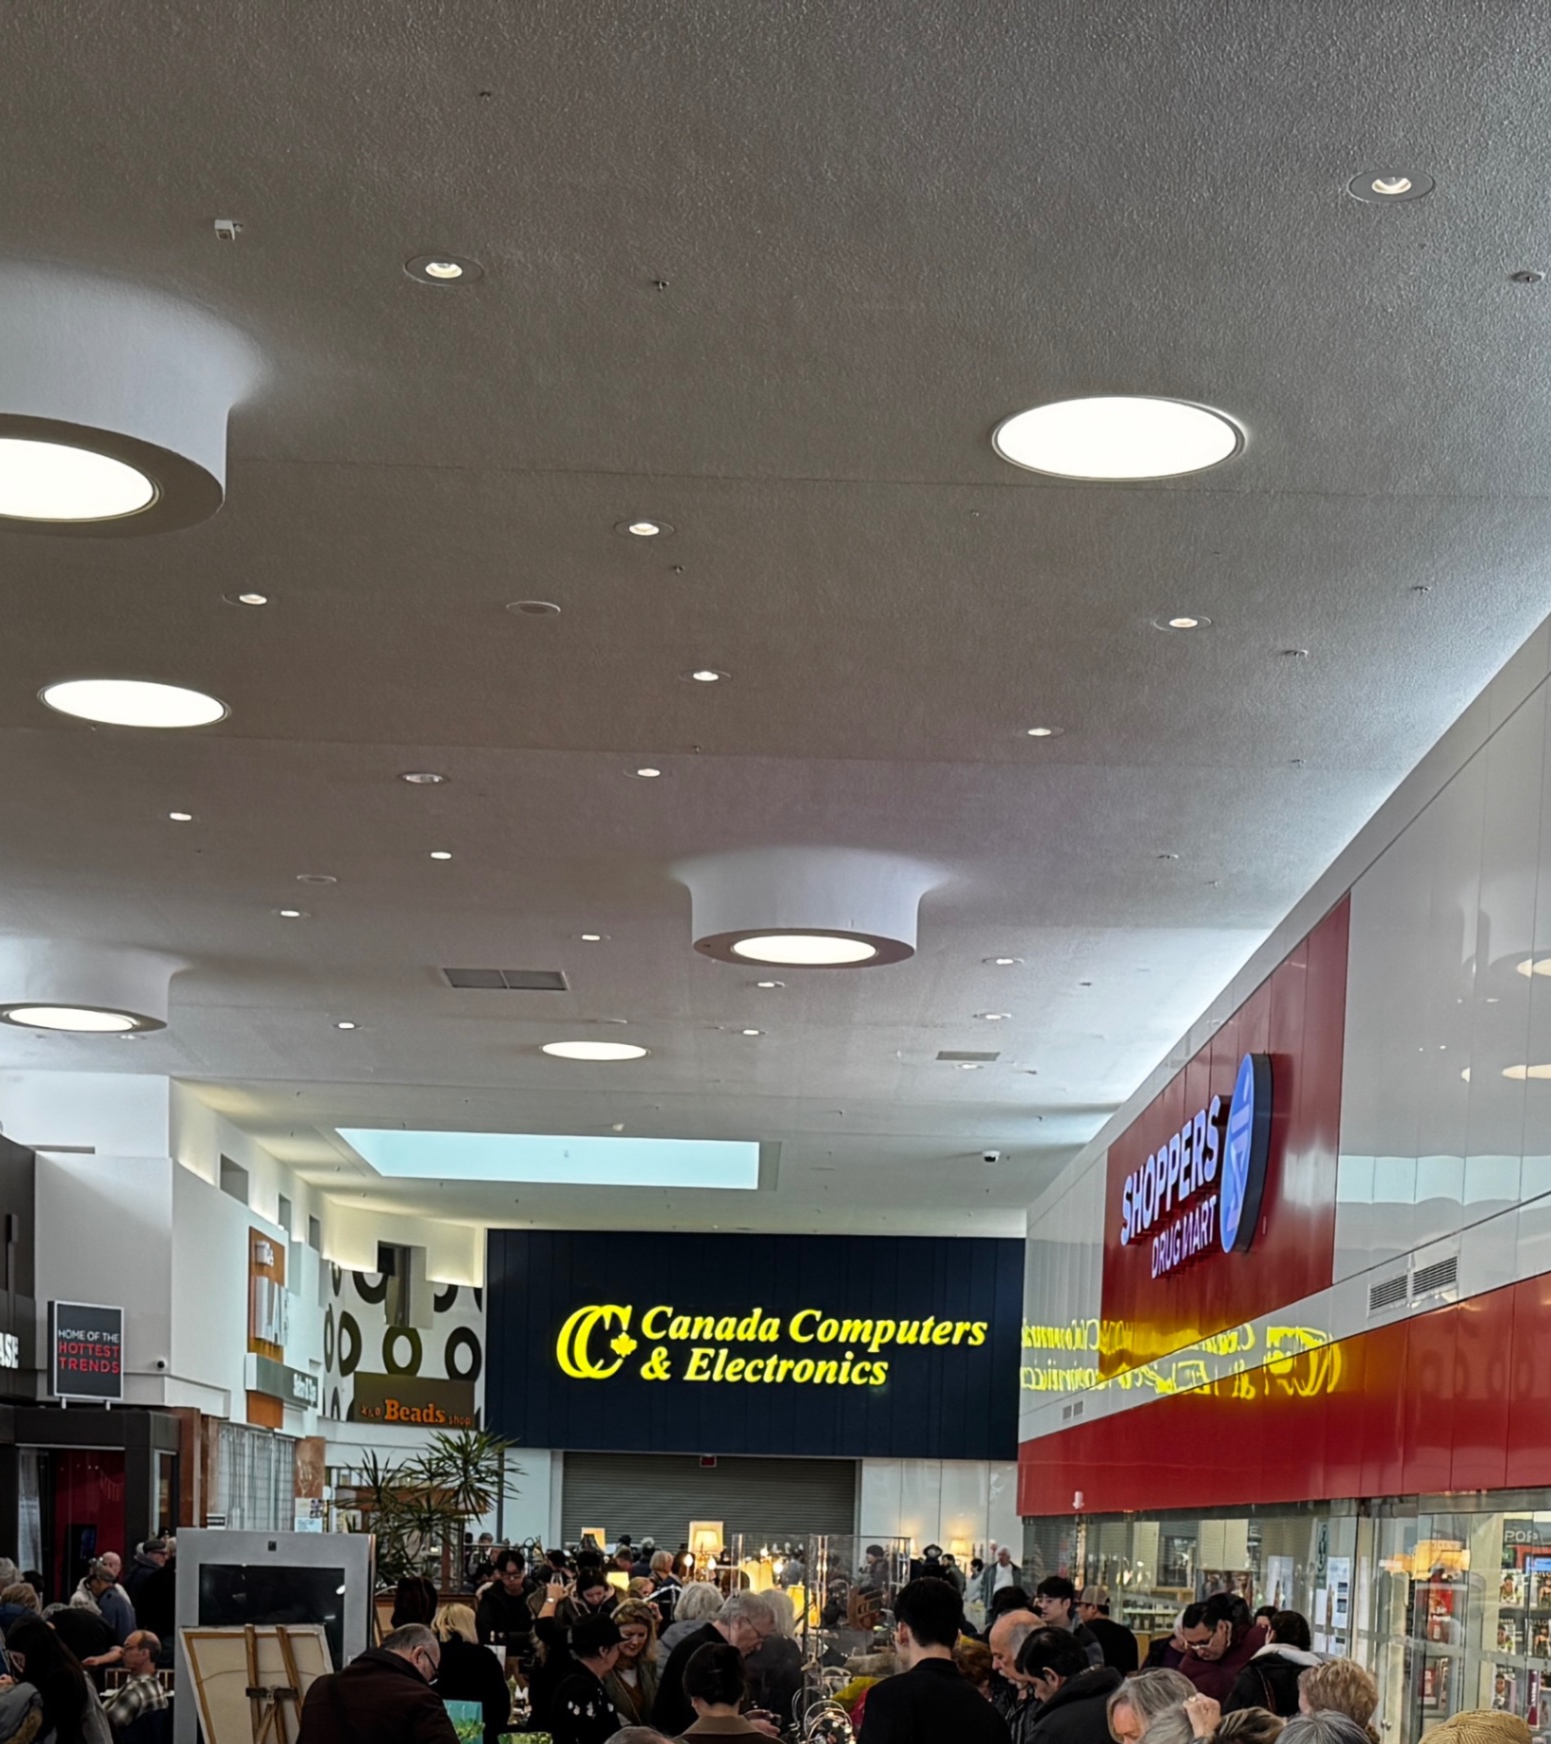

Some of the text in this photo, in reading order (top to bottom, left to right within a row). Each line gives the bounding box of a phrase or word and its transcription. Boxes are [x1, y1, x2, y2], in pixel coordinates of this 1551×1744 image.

[1120, 1094, 1221, 1246] SHOPPERS
[1151, 1195, 1217, 1280] DRUG MART
[58, 1329, 119, 1343] HOME OF THE
[641, 1305, 781, 1343] Canada
[788, 1308, 988, 1353] Computers
[59, 1341, 120, 1358] HOTTEST
[59, 1357, 120, 1374] TRENDS
[640, 1346, 889, 1385] & Electronics
[384, 1398, 447, 1423] Beads
